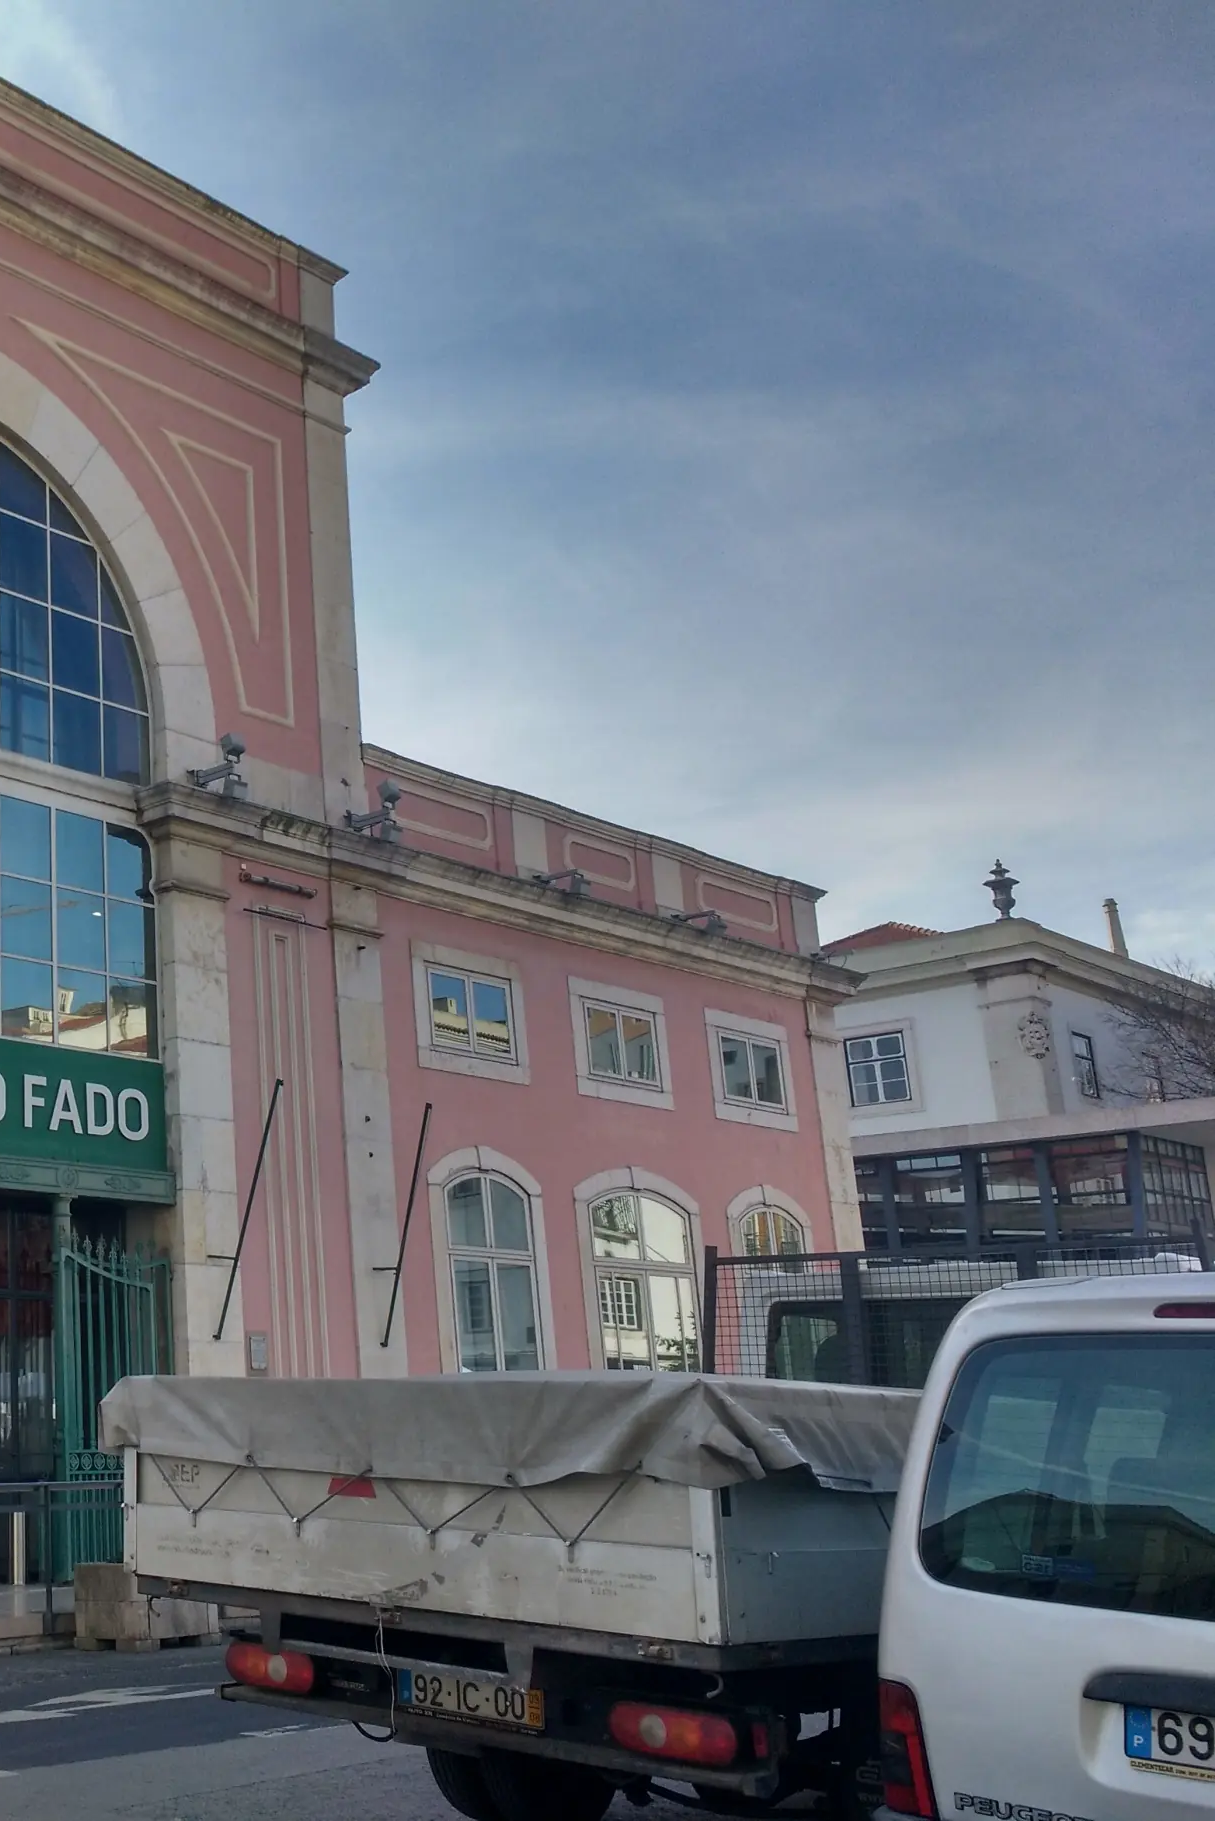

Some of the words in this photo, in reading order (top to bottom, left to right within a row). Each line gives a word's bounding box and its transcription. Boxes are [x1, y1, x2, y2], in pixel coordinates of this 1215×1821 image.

[23, 1073, 151, 1142] FADO
[1133, 1734, 1144, 1748] P
[1157, 1710, 1215, 1761] 69
